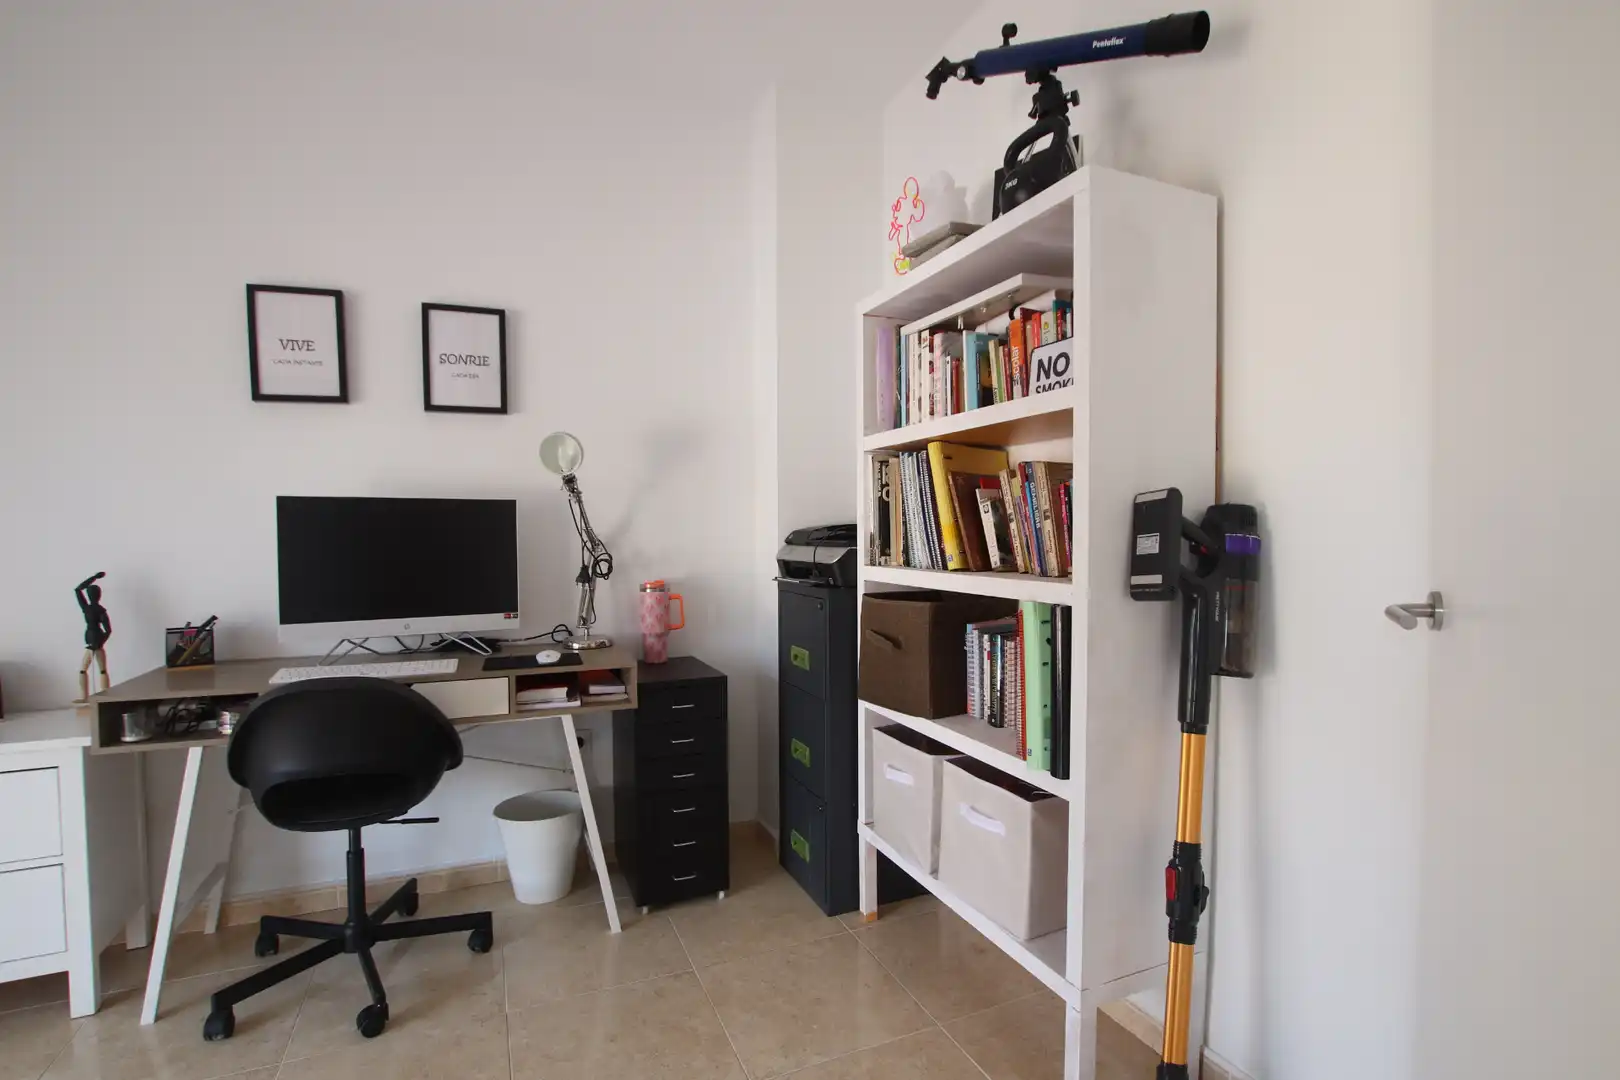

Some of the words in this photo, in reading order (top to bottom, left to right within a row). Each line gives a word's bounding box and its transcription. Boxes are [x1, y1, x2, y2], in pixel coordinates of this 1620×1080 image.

[278, 338, 316, 351] VIVE
[439, 353, 491, 366] SONRIE
[1036, 351, 1071, 383] NO
